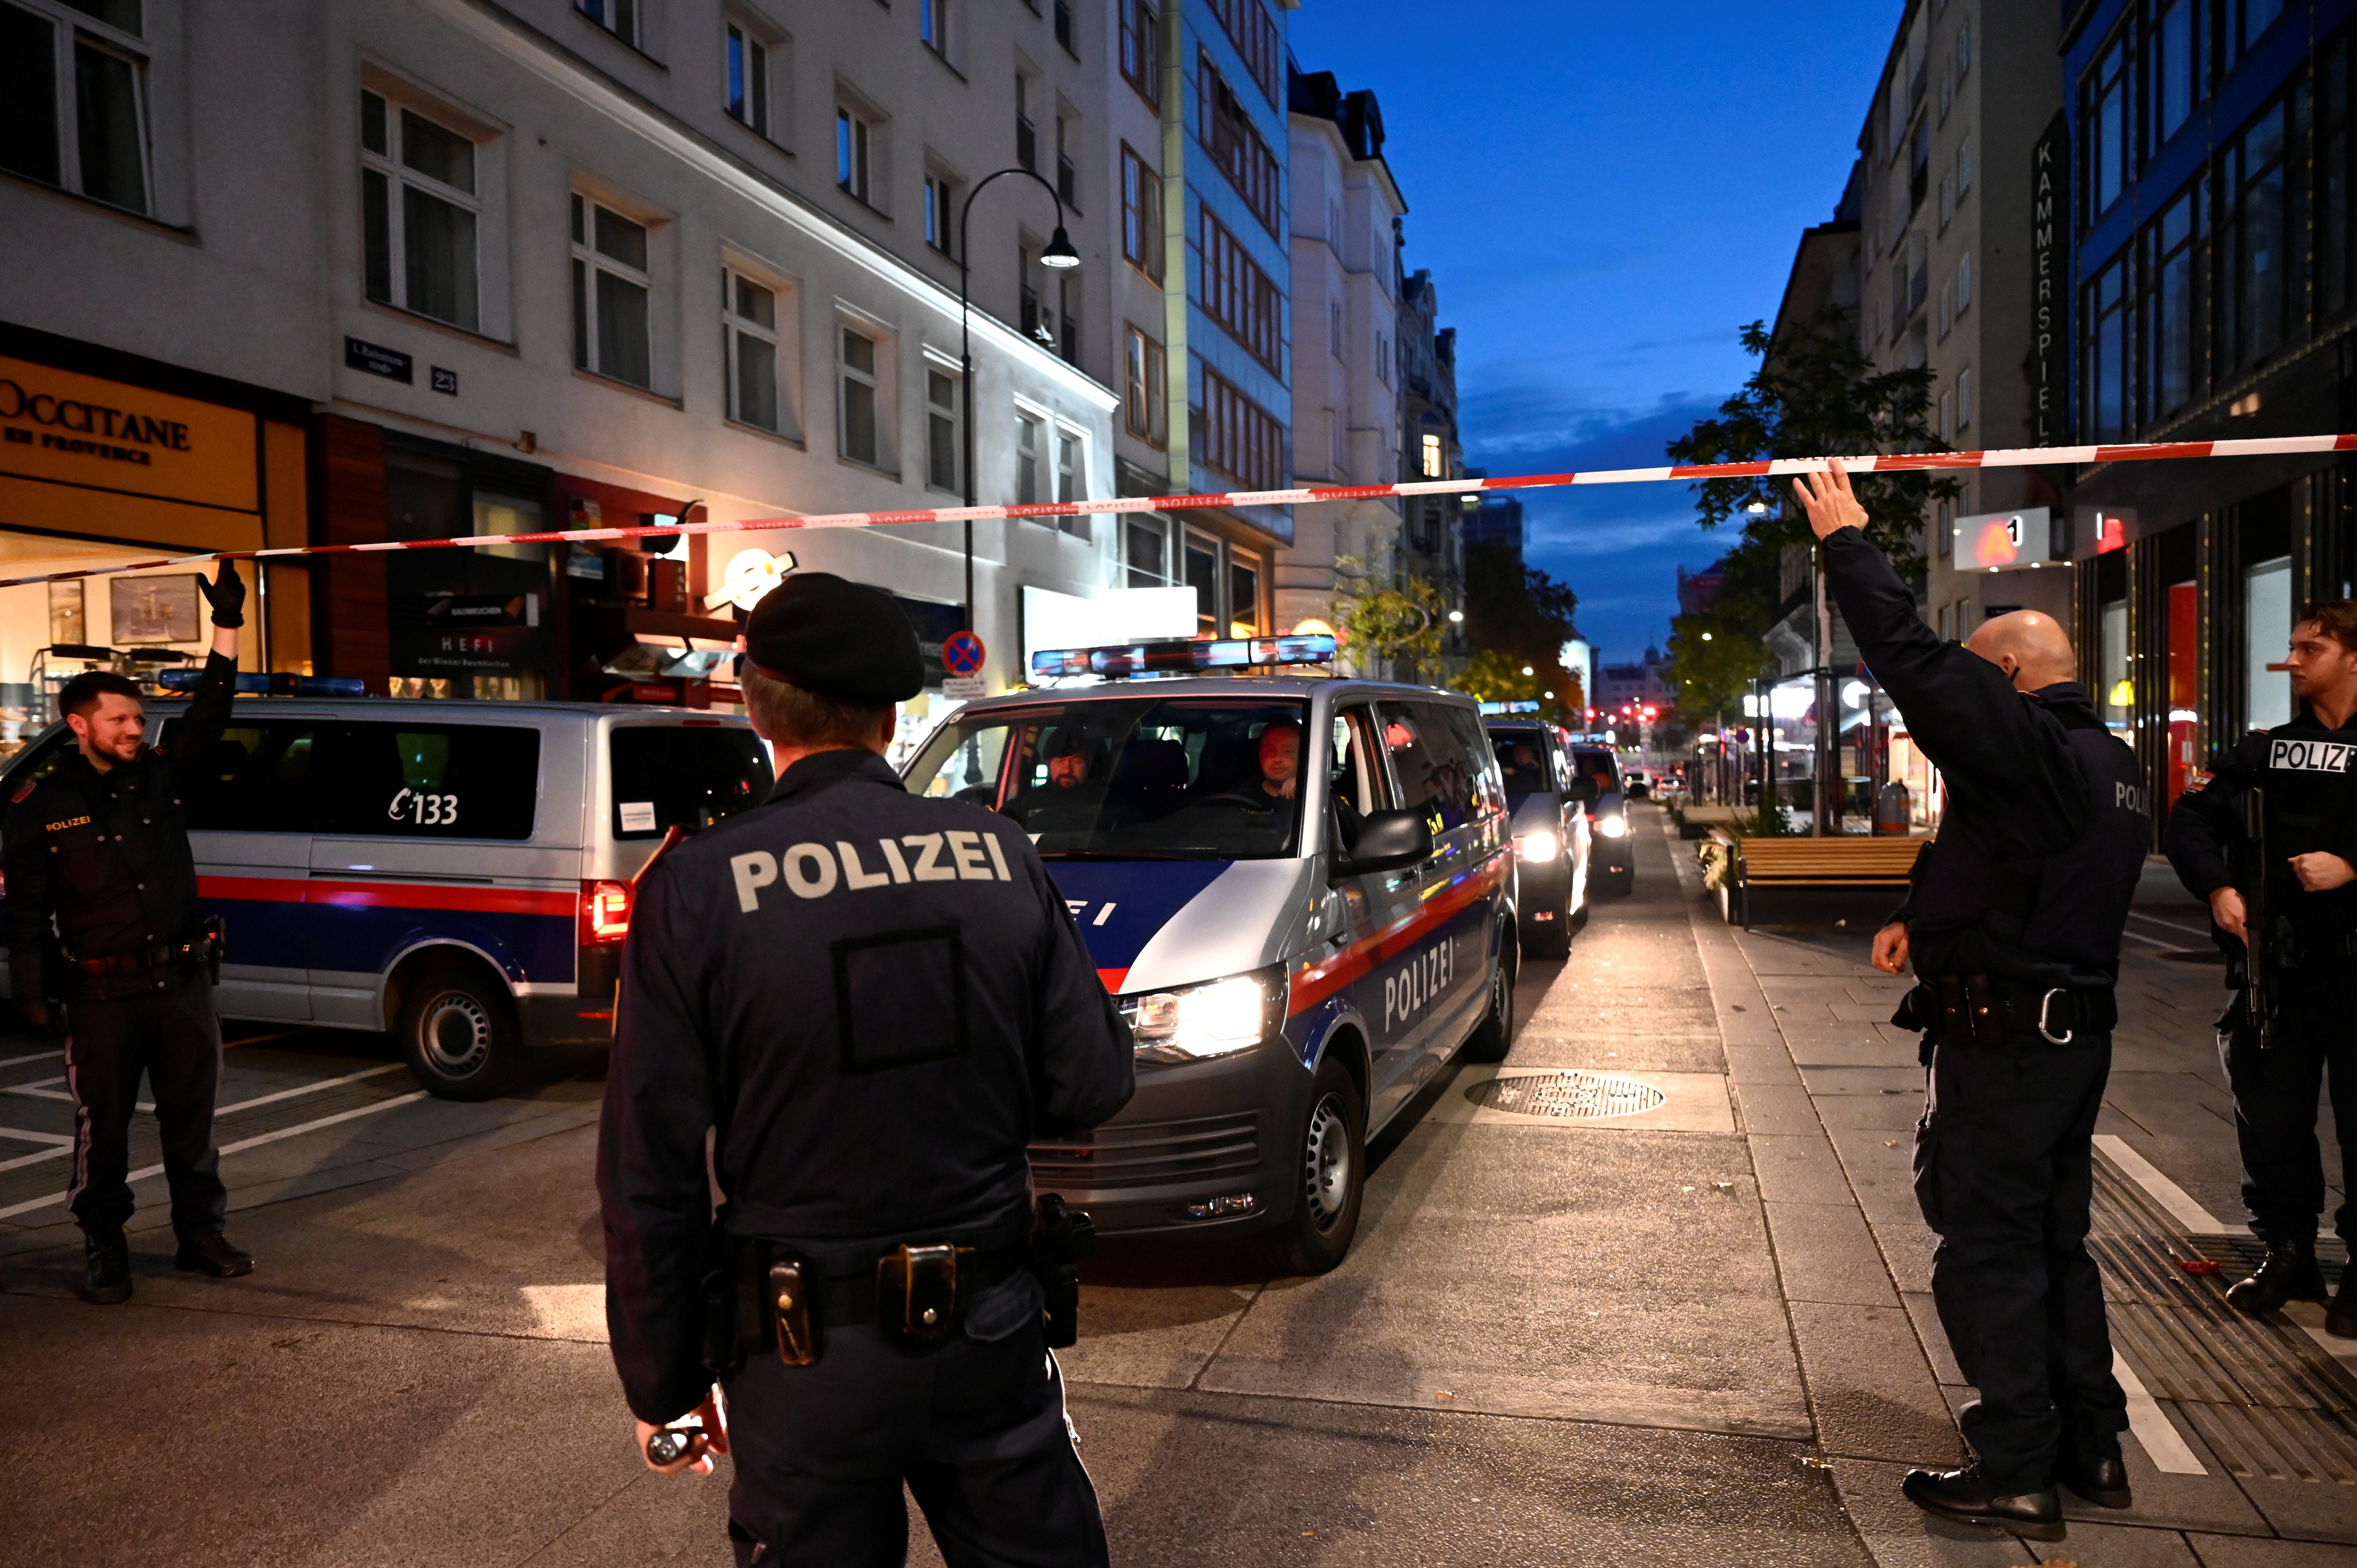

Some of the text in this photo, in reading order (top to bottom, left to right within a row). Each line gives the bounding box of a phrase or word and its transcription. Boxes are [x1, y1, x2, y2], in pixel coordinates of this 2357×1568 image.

[435, 370, 454, 392] 23
[42, 433, 151, 466] PROVENCE
[1977, 516, 2023, 566] A1
[441, 636, 493, 653] HEFI
[46, 815, 91, 832] POLIZEI
[413, 794, 458, 825] 133
[730, 830, 1012, 914] POLIZEI
[1385, 936, 1453, 1033] POLIZEI
